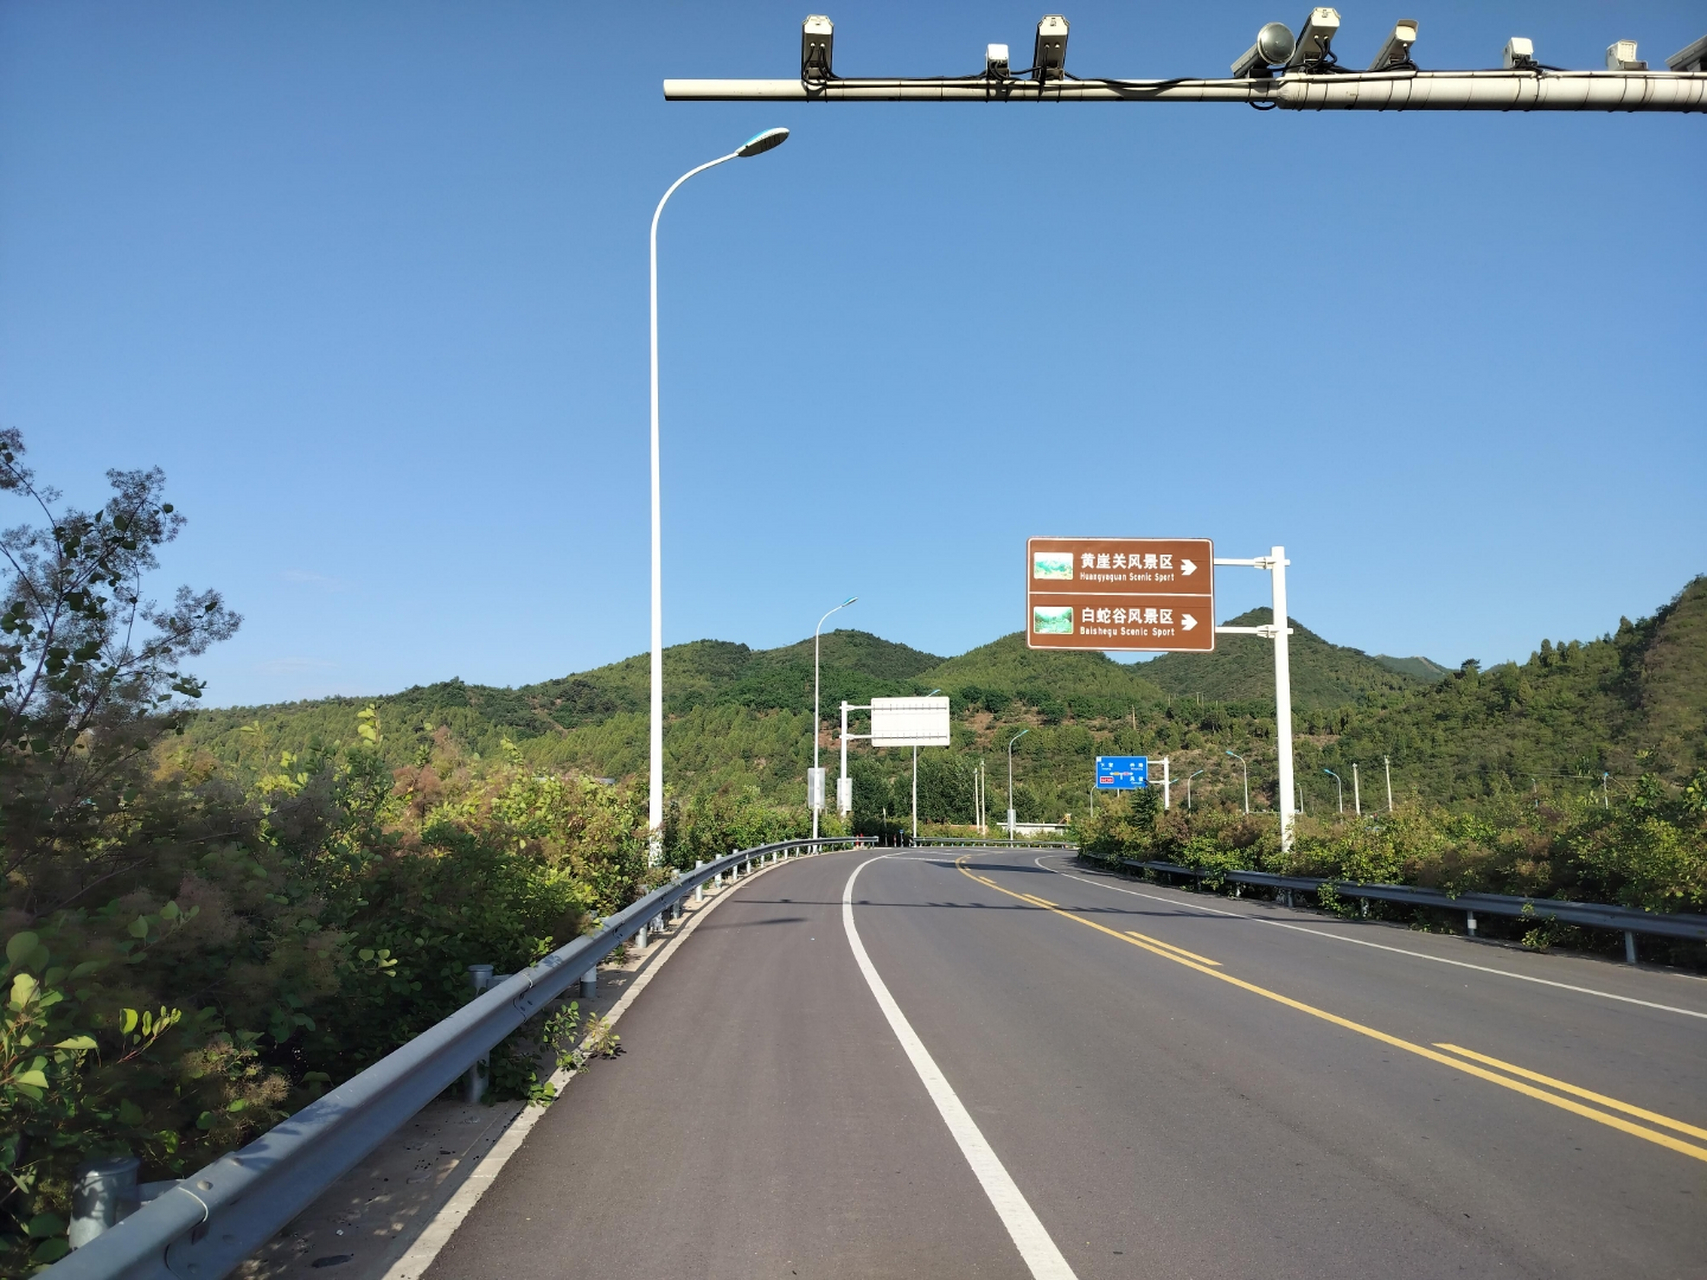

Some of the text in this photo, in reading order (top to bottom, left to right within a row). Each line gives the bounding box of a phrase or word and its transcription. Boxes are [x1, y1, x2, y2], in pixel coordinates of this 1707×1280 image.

[1080, 553, 1173, 569] 黄崖关风景区
[1129, 572, 1152, 582] Scenic
[1154, 573, 1174, 583] Sport
[1081, 607, 1174, 624] 白蛇谷风景区
[1120, 627, 1148, 636] Scenic
[1152, 627, 1175, 638] Sport
